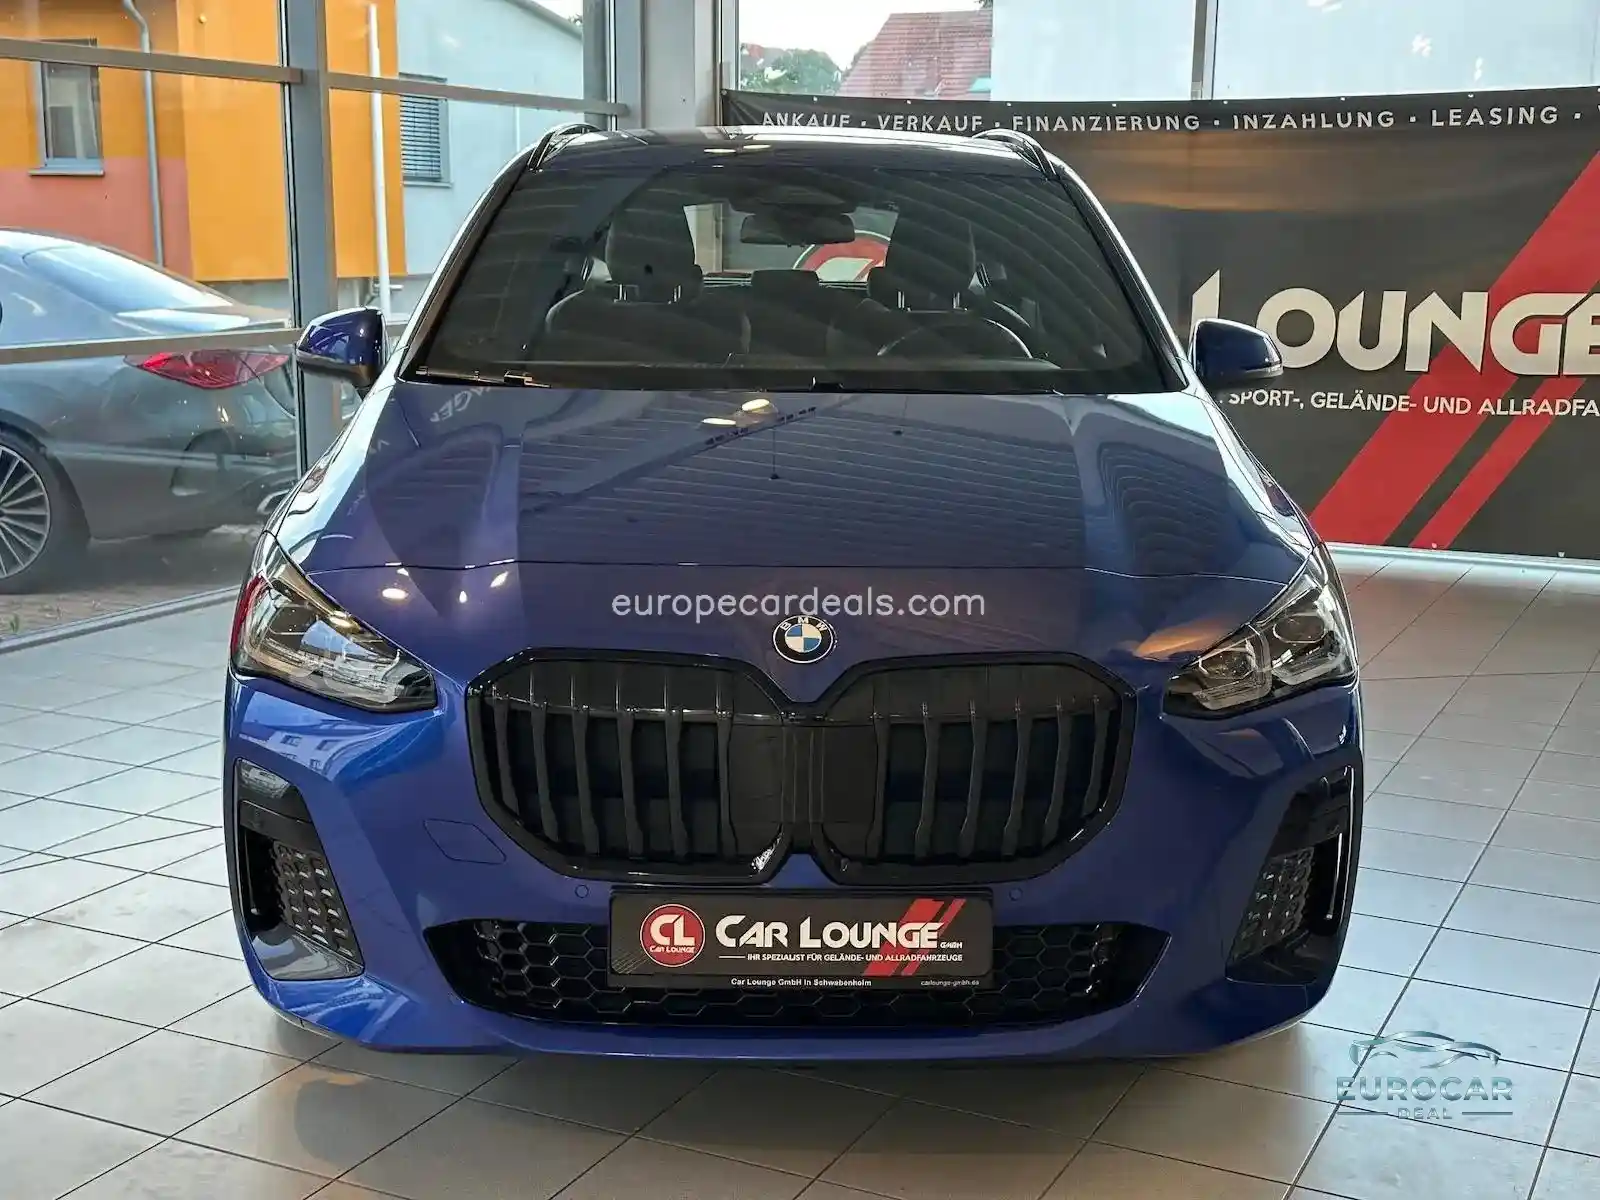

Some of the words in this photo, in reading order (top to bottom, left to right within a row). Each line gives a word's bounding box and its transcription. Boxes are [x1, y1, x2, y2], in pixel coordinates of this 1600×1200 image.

[762, 112, 851, 128] ANKAUF
[877, 115, 983, 132] VERKAUF
[1012, 115, 1200, 132] FINANZIERUNG
[1233, 111, 1395, 130] INZAHLUNG
[1431, 106, 1558, 126] LEASING
[1310, 390, 1417, 413] GELÄNDE-
[1423, 396, 1472, 414] UND
[1478, 398, 1600, 417] ALLRADFA
[779, 616, 828, 632] BMW
[650, 914, 695, 946] CL
[715, 915, 788, 948] CAR
[800, 916, 945, 949] LOUNGE
[649, 945, 665, 953] CAR
[666, 946, 695, 954] LOUNGE
[747, 953, 761, 961] IHR
[762, 953, 806, 961] SPEZIALIST
[807, 952, 822, 961] FÜR
[824, 953, 864, 961] GELÄNDE-
[865, 953, 884, 961] UND
[885, 954, 963, 962] ALLRADFAHRZEUGE
[731, 978, 745, 986] Car
[746, 979, 777, 987] Lounge
